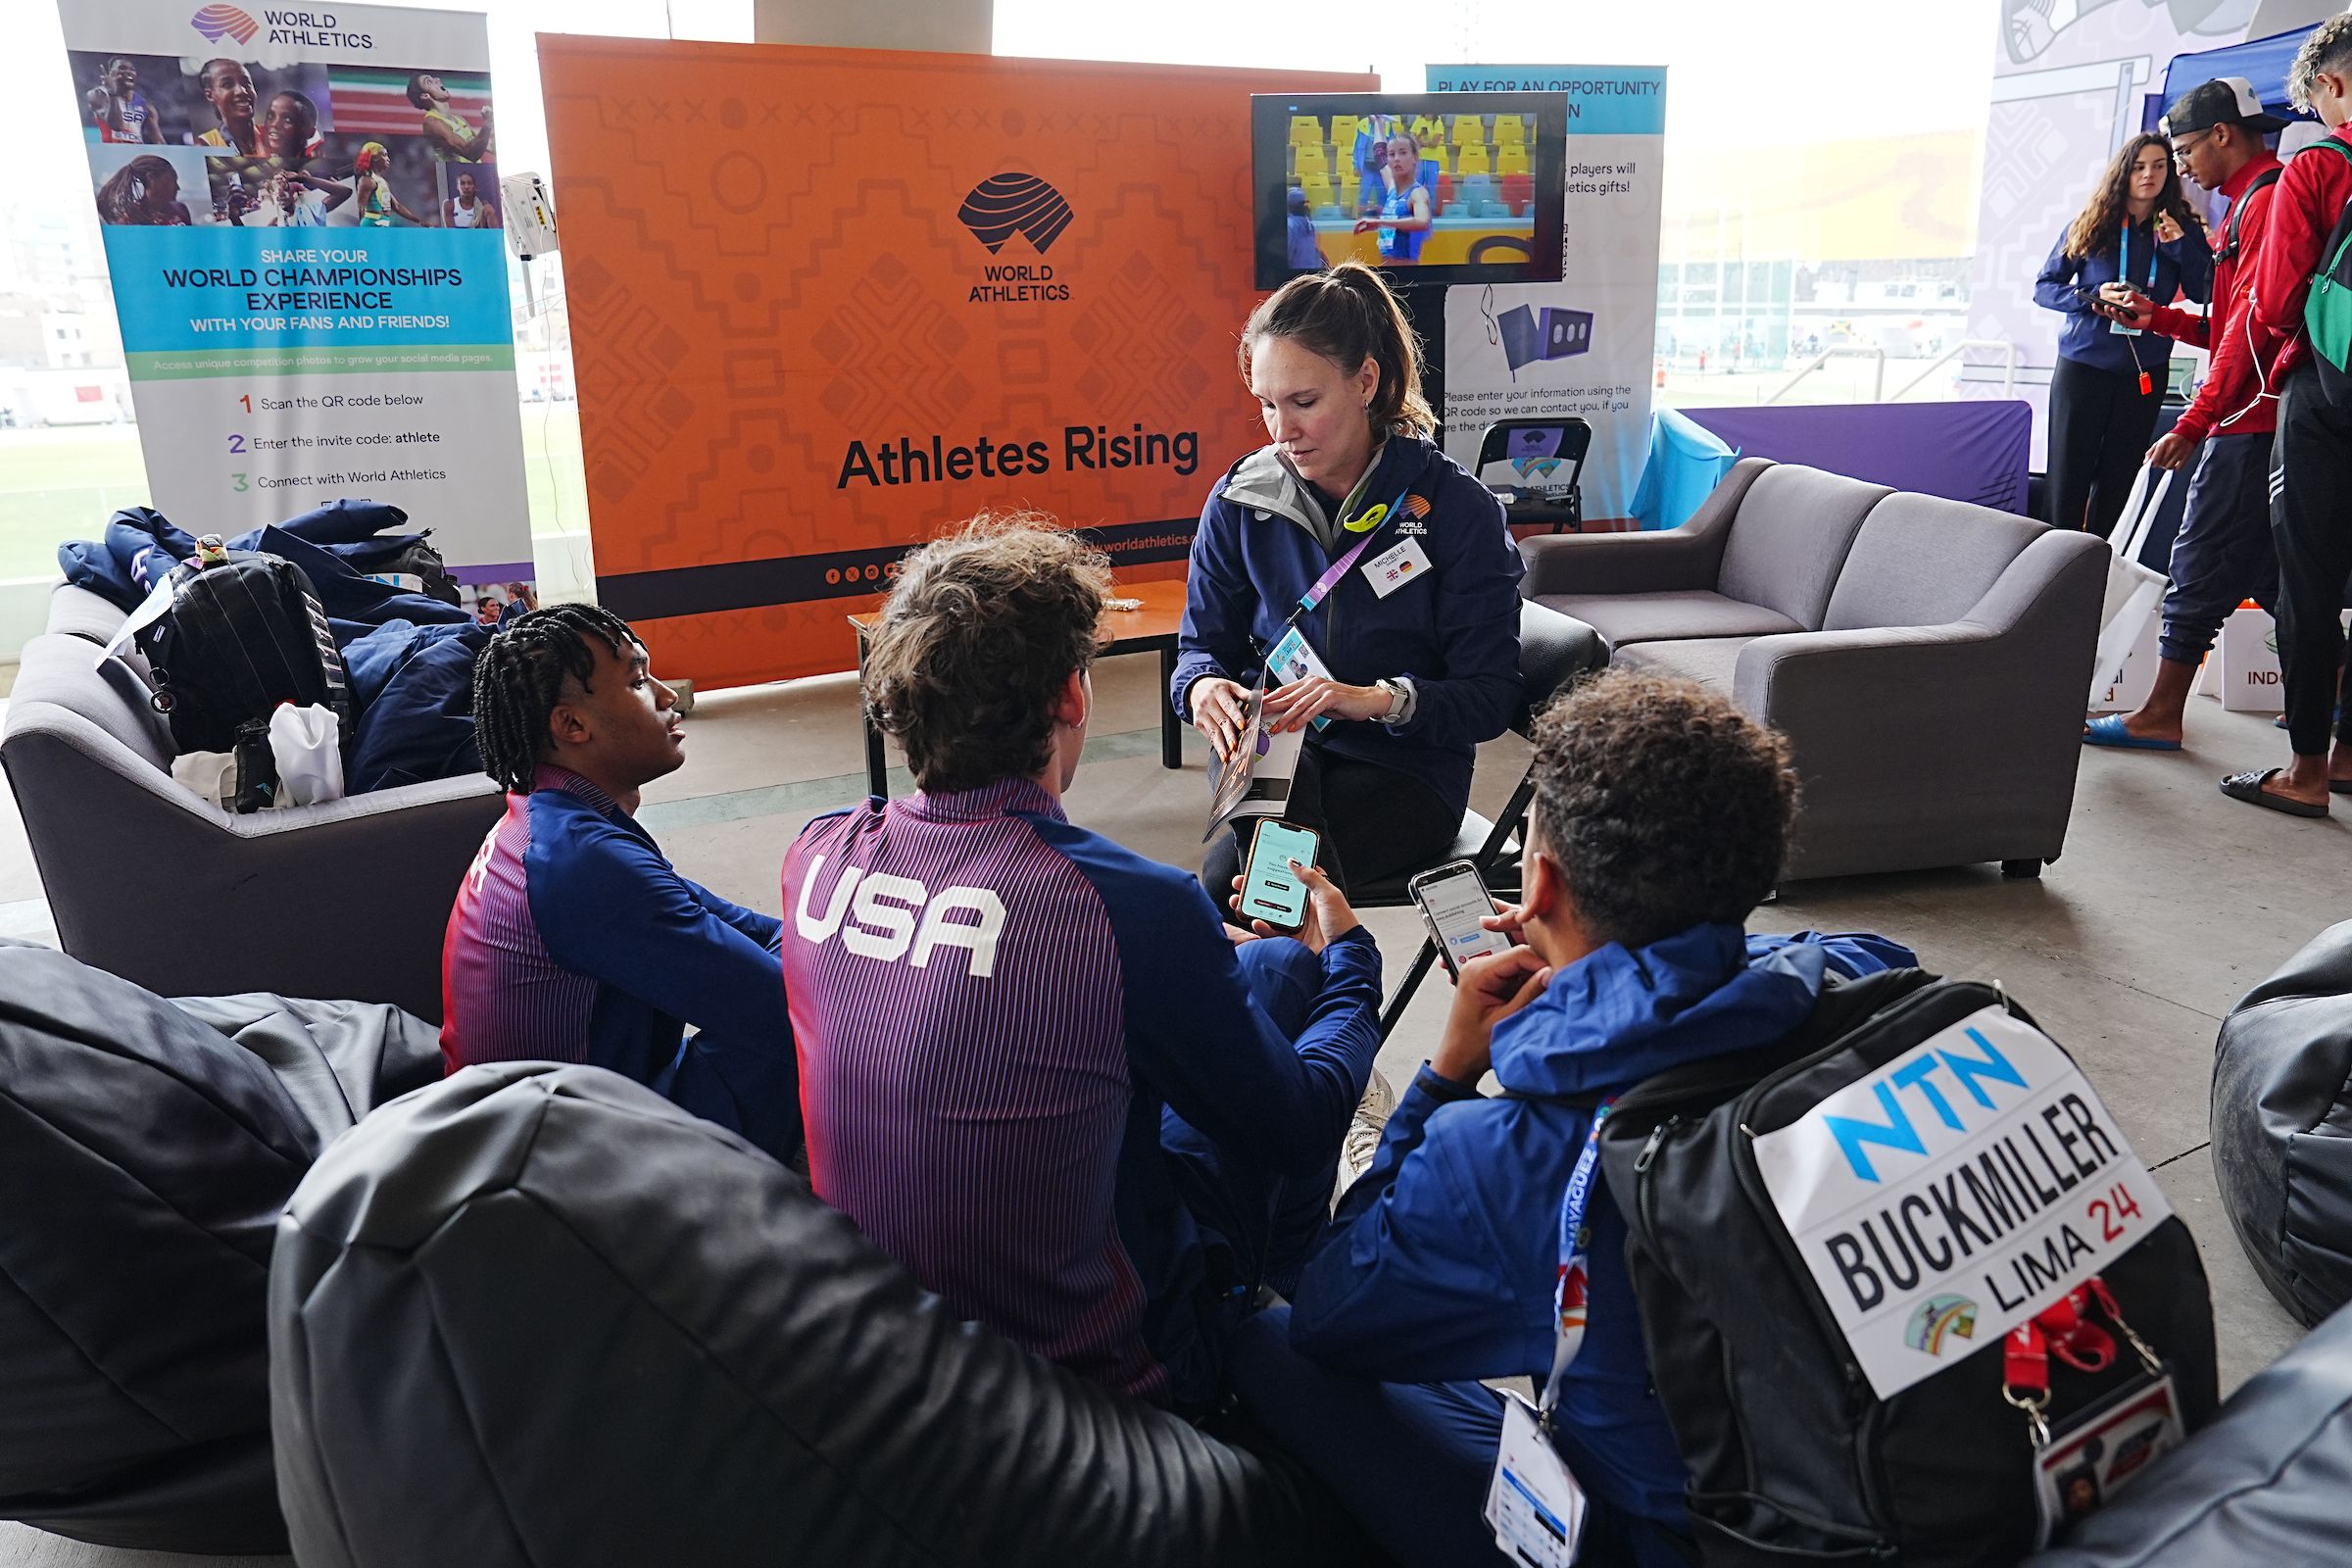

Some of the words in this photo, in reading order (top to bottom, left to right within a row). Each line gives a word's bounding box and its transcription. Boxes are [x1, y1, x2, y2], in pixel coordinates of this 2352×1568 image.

[264, 10, 336, 28] WORLD
[269, 28, 372, 49] ATHLETICS
[1438, 80, 1480, 91] PLAY
[1484, 80, 1516, 91] FOR
[1521, 80, 1544, 91] AN
[1548, 80, 1660, 95] OPPORTUNITY
[1571, 163, 1612, 177] players
[1617, 163, 1636, 173] will
[1598, 180, 1630, 196] gifts!
[261, 249, 317, 264] SHARE
[320, 249, 368, 263] YOUR
[163, 269, 257, 287] WORLD
[264, 268, 463, 287] CHAMPIONSHIPS
[984, 266, 1053, 281] WORLD
[246, 291, 393, 311] EXPERIENCE
[968, 284, 1069, 303] ATHLETICS
[189, 318, 236, 332] WITH
[240, 318, 287, 330] YOUR
[290, 317, 334, 330] FANS
[337, 316, 374, 329] AND
[377, 315, 450, 328] FRIENDS!
[153, 360, 193, 370] Access
[195, 358, 231, 369] unique
[233, 356, 294, 368] competition
[296, 354, 332, 367] photos
[348, 356, 372, 366] grow
[375, 355, 398, 366] your
[400, 353, 428, 363] social
[430, 353, 460, 363] media
[462, 354, 493, 365] pages.
[1444, 392, 1475, 403] Please
[1477, 392, 1503, 401] enter
[1506, 391, 1529, 402] your
[1530, 387, 1586, 399] information
[1588, 386, 1613, 398] using
[1615, 385, 1631, 395] the
[239, 394, 252, 414] 1
[261, 398, 293, 411] Scan
[296, 397, 318, 409] the
[321, 395, 344, 409] QR
[347, 395, 381, 407] code
[384, 394, 423, 406] below
[1444, 407, 1458, 417] QR
[1460, 407, 1487, 416] code
[1521, 405, 1538, 415] can
[1540, 403, 1577, 414] contact
[1602, 400, 1610, 410] if
[1611, 401, 1629, 413] you
[1459, 421, 1476, 431] the
[227, 434, 246, 454] 2
[254, 437, 287, 450] Enter
[291, 436, 314, 448] the
[316, 434, 353, 446] invite
[356, 433, 392, 445] code:
[395, 431, 440, 444] athlete
[837, 434, 1050, 490] Athletes
[1063, 422, 1198, 475] Rising
[231, 472, 249, 492] 3
[258, 475, 313, 489] Connect
[317, 472, 345, 484] with
[347, 470, 386, 484] World
[390, 468, 446, 481] Athletics
[1374, 546, 1406, 568] MICHELLE
[796, 855, 1007, 978] USA
[1822, 1026, 2031, 1184] NTN
[1825, 1092, 2119, 1313] BUCKMILLER
[1984, 1222, 2095, 1315] LIMA
[2087, 1182, 2142, 1244] 24
